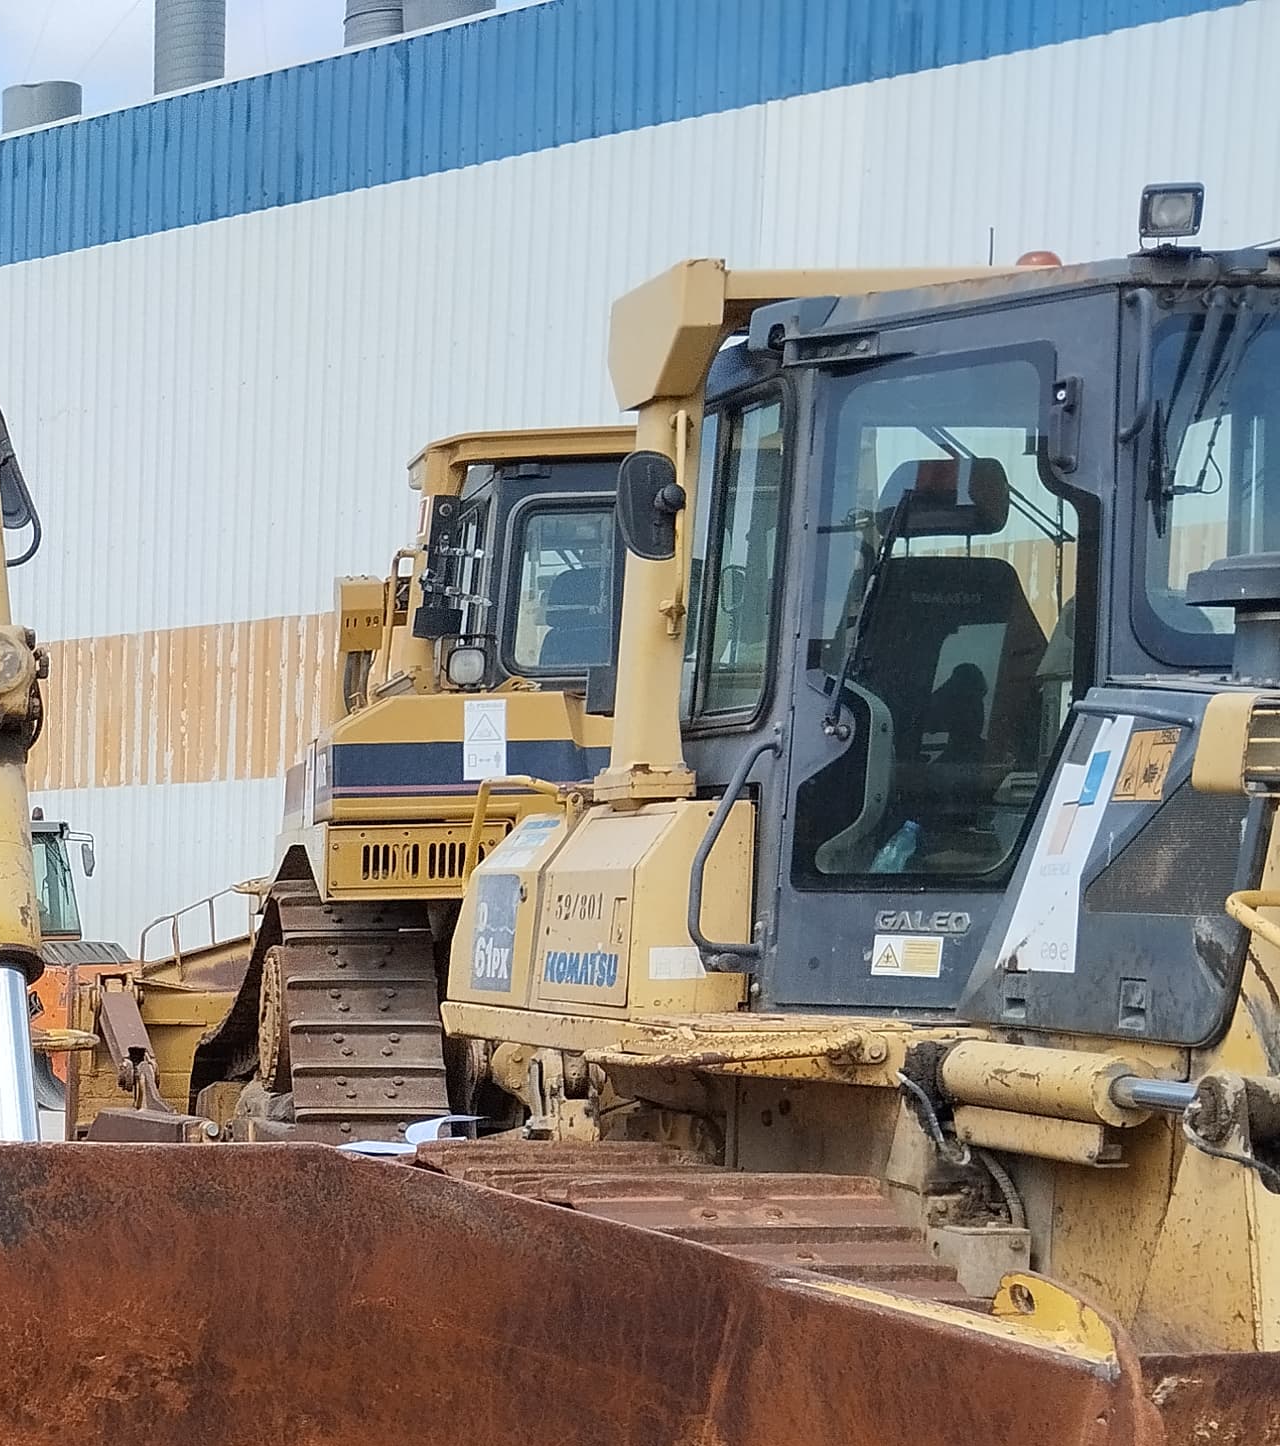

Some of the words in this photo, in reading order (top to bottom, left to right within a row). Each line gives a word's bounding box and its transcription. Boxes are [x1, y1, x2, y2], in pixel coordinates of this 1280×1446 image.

[875, 910, 971, 934] GALEO
[475, 936, 511, 979] 61PX
[543, 947, 620, 988] KOMATSU
